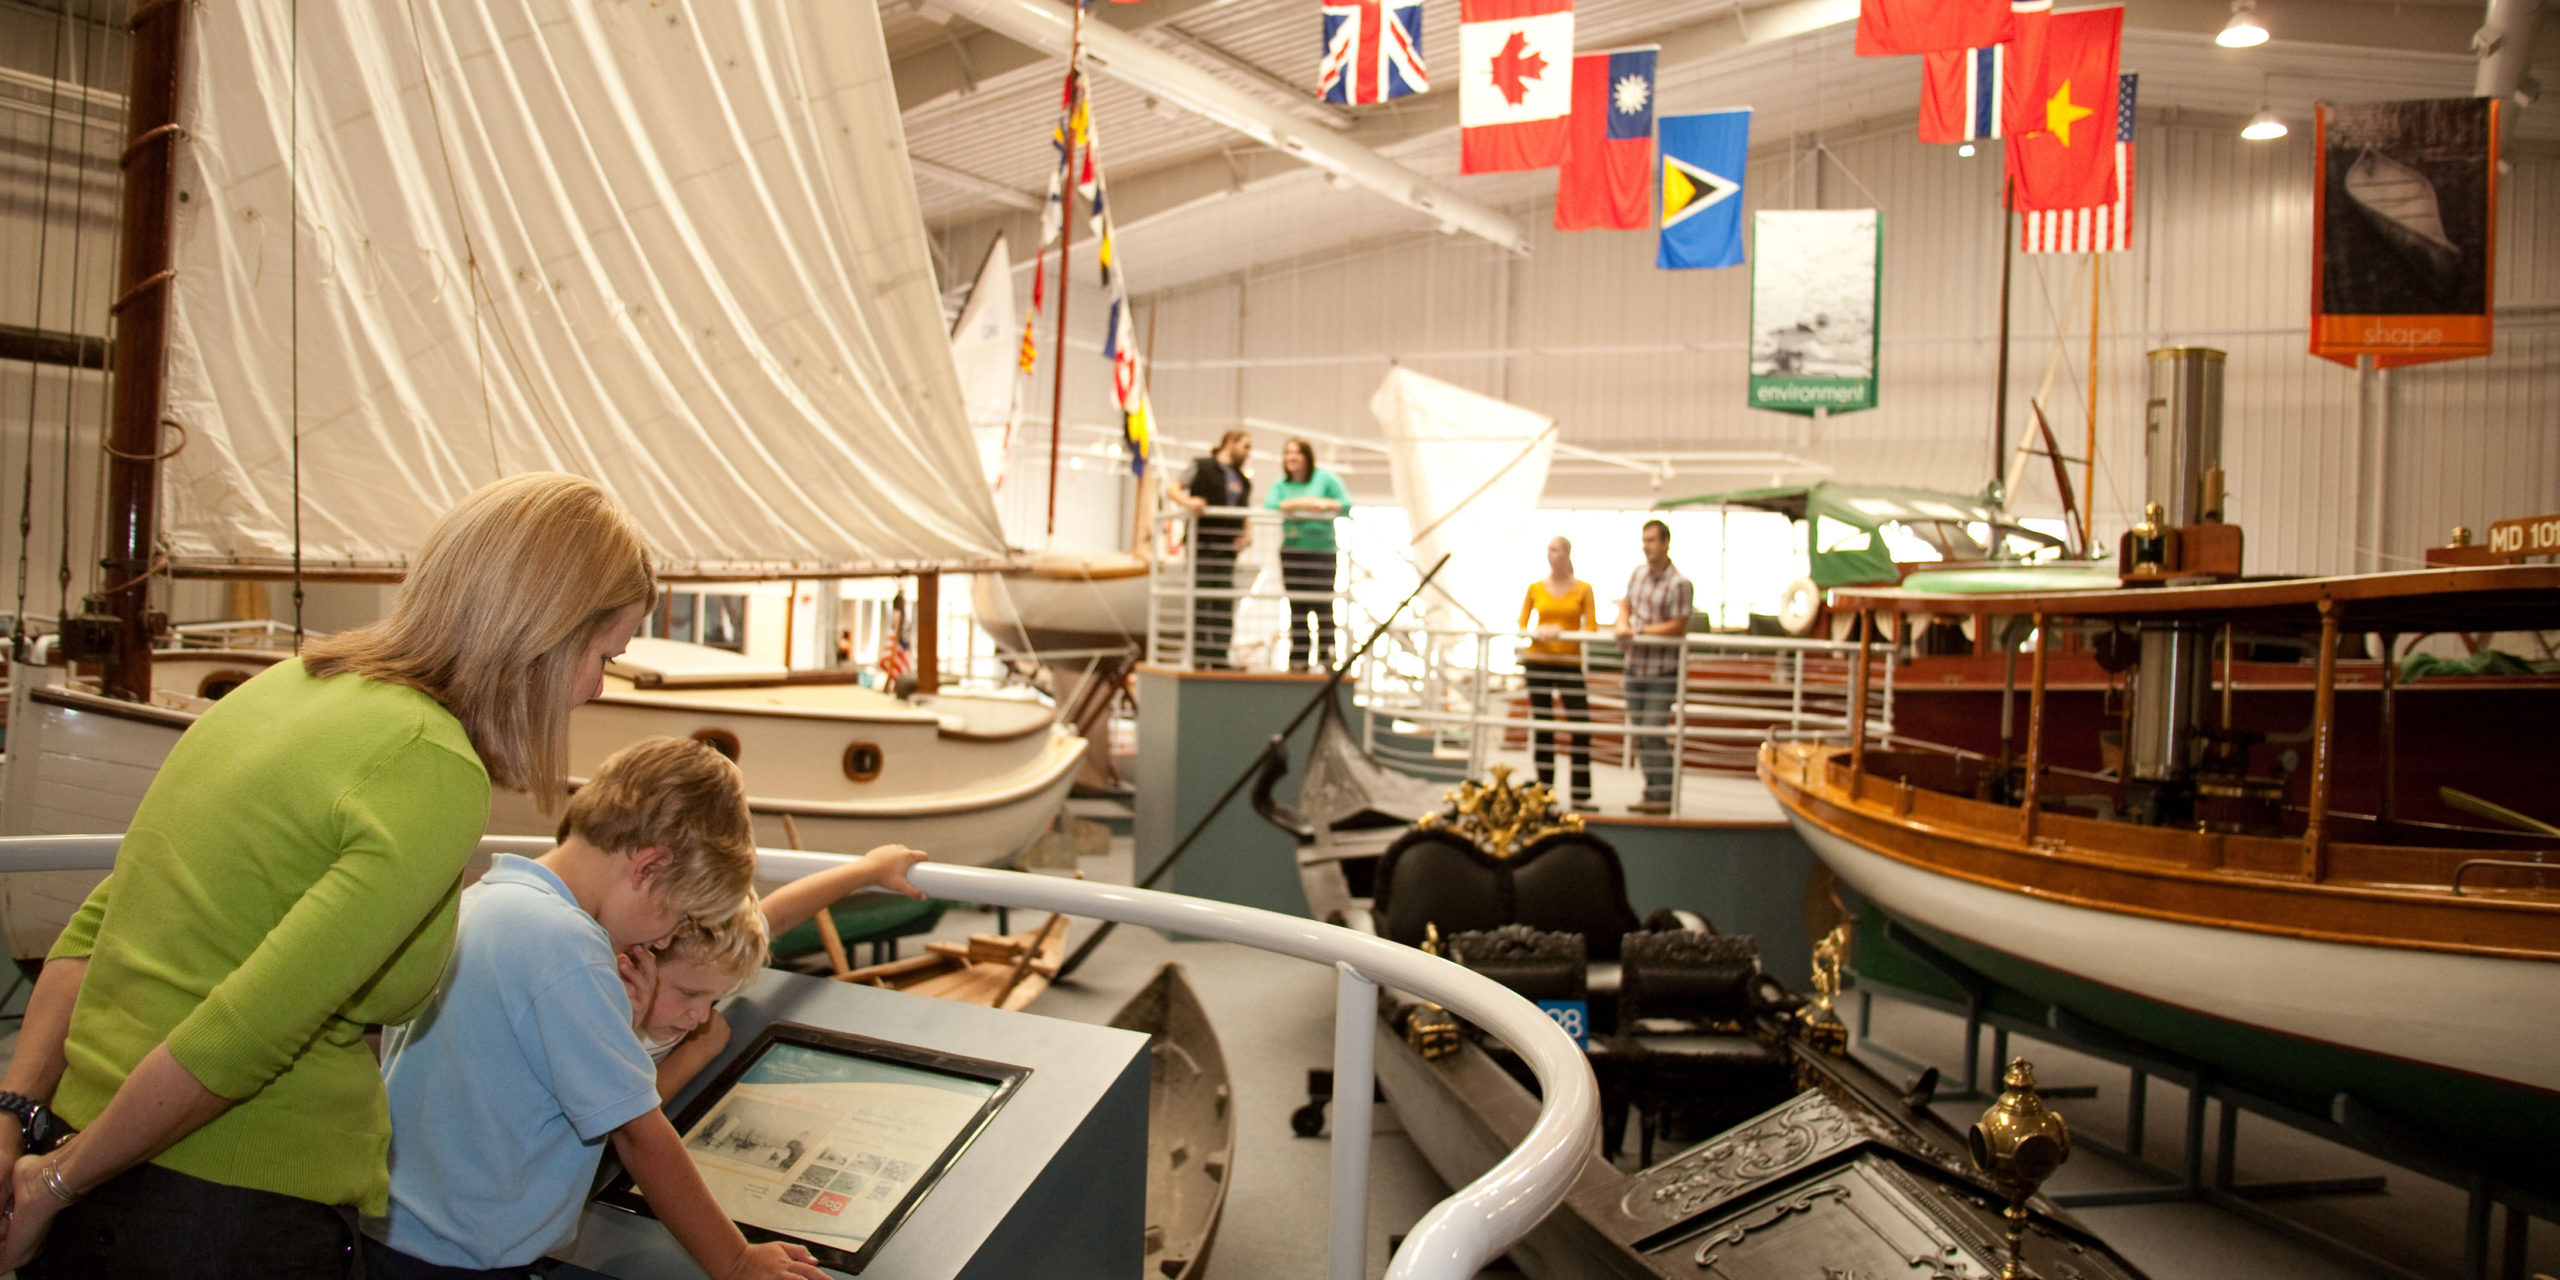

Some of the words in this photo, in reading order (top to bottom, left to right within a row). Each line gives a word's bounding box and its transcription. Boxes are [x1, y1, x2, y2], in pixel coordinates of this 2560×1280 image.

[2364, 317, 2442, 352] shape
[1757, 382, 1864, 402] environment
[2490, 525, 2523, 554] MD
